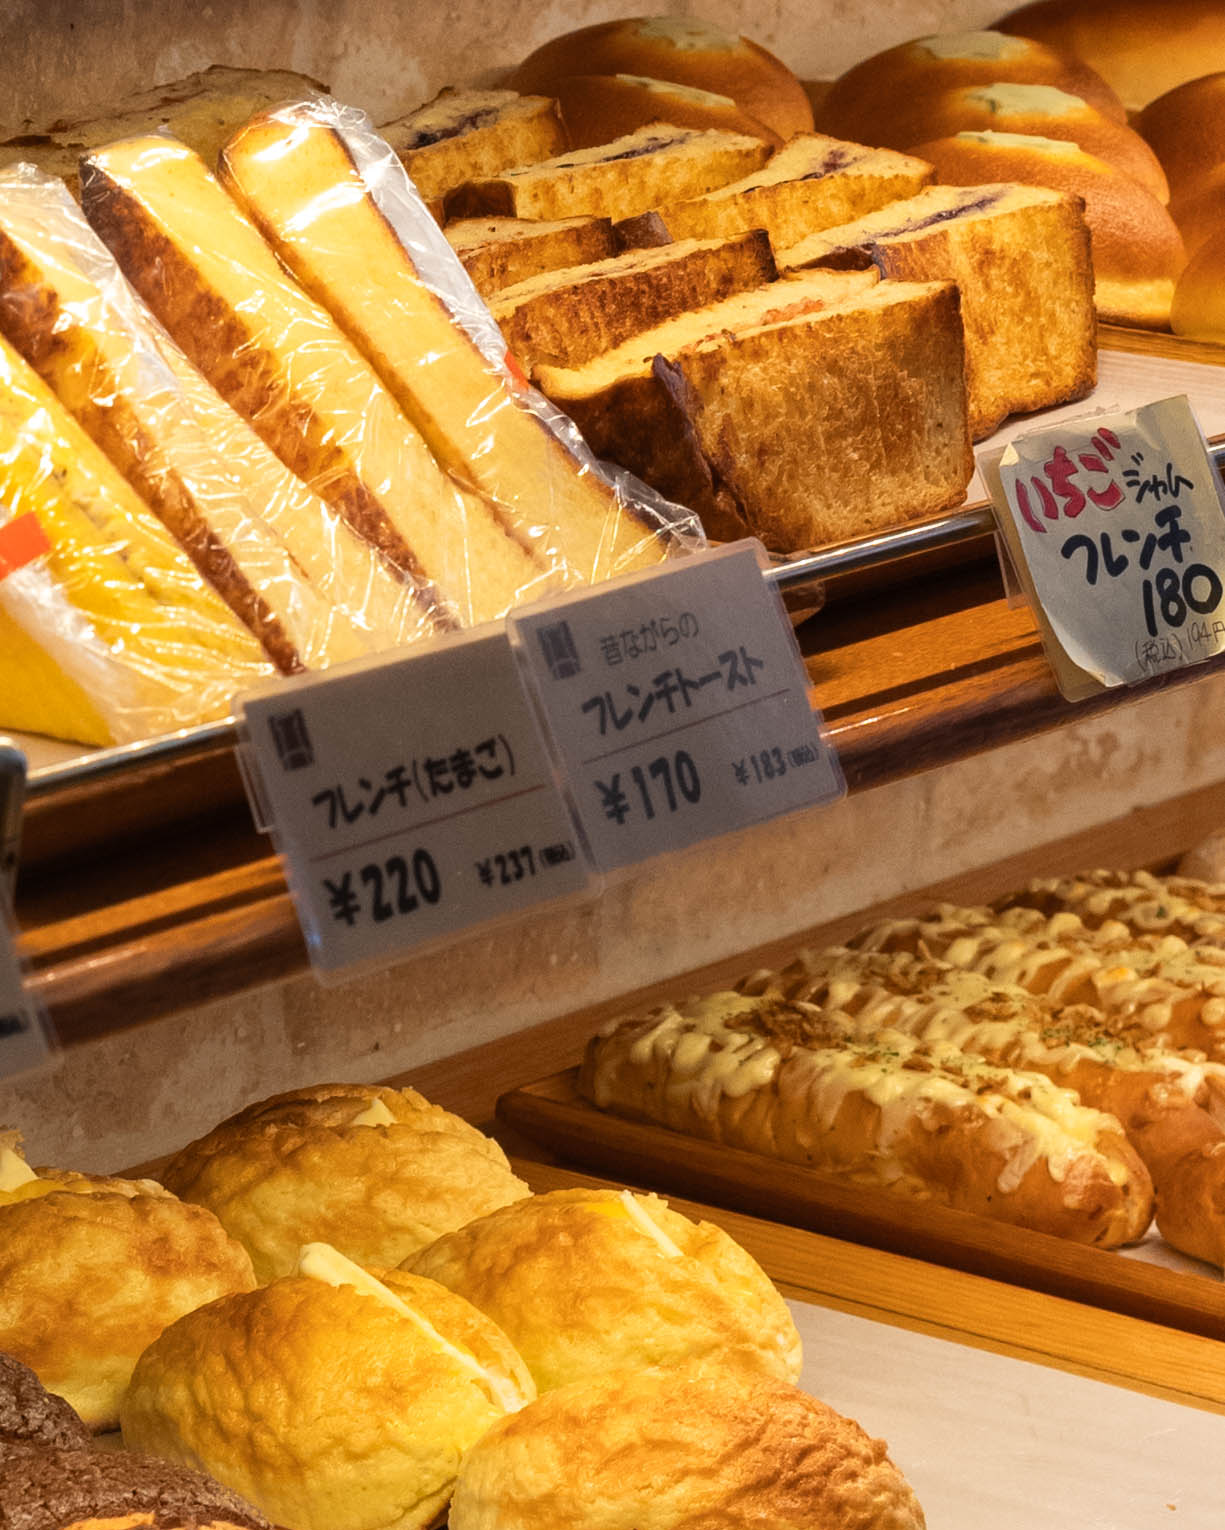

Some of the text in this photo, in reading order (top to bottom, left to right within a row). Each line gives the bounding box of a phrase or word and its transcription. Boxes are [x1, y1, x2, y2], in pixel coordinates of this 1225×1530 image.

[1061, 505, 1191, 586] フレンチ
[600, 611, 700, 666] 昔ながらの
[1142, 563, 1224, 637] 180
[581, 646, 764, 736] フレンチトースト
[312, 733, 515, 829] フレンチ(たまご)
[594, 750, 702, 825] ¥170
[731, 746, 786, 786] ¥183
[322, 848, 442, 926] ¥220
[474, 845, 535, 888] ¥237
